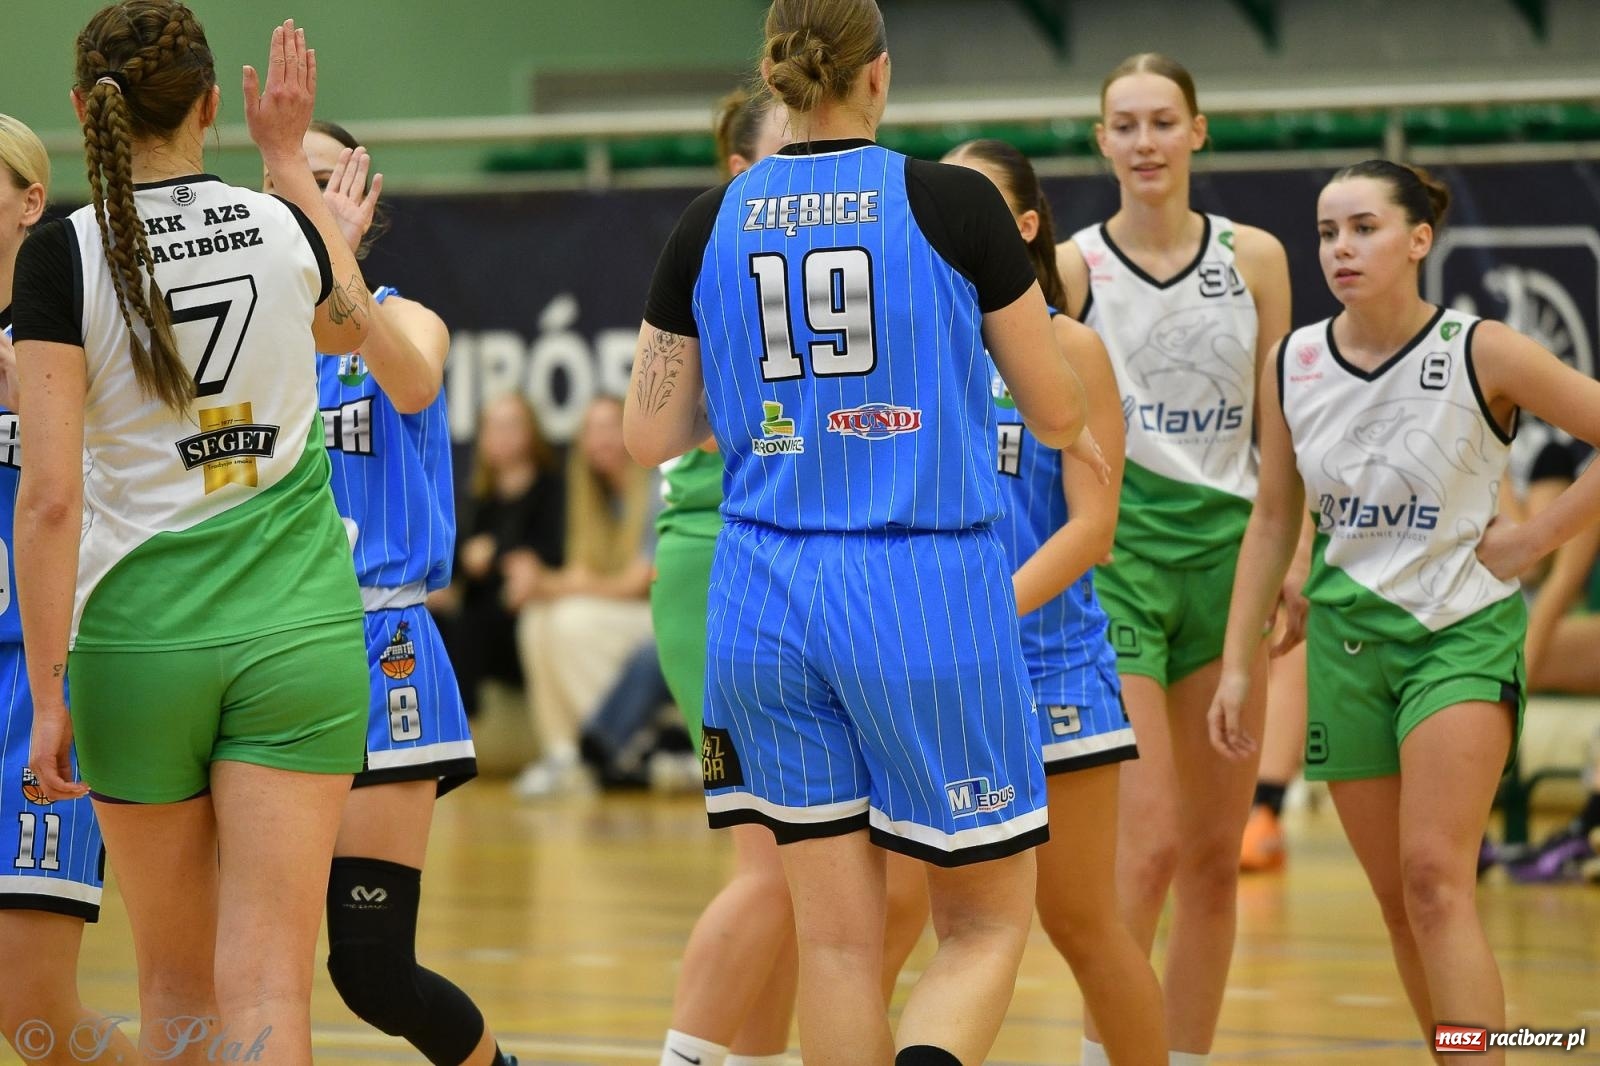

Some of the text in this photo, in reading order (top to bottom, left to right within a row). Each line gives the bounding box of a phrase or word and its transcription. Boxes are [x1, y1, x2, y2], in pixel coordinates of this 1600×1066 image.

[143, 203, 250, 236] KK AZS
[743, 190, 878, 237] ZIĘBICE
[165, 274, 257, 397] 7
[749, 246, 877, 382] 19
[1420, 351, 1451, 390] 8
[829, 410, 921, 430] MUNDI
[1139, 398, 1243, 433] Clavis
[187, 431, 272, 462] SEGET
[389, 685, 422, 742] 8
[14, 812, 60, 871] 11
